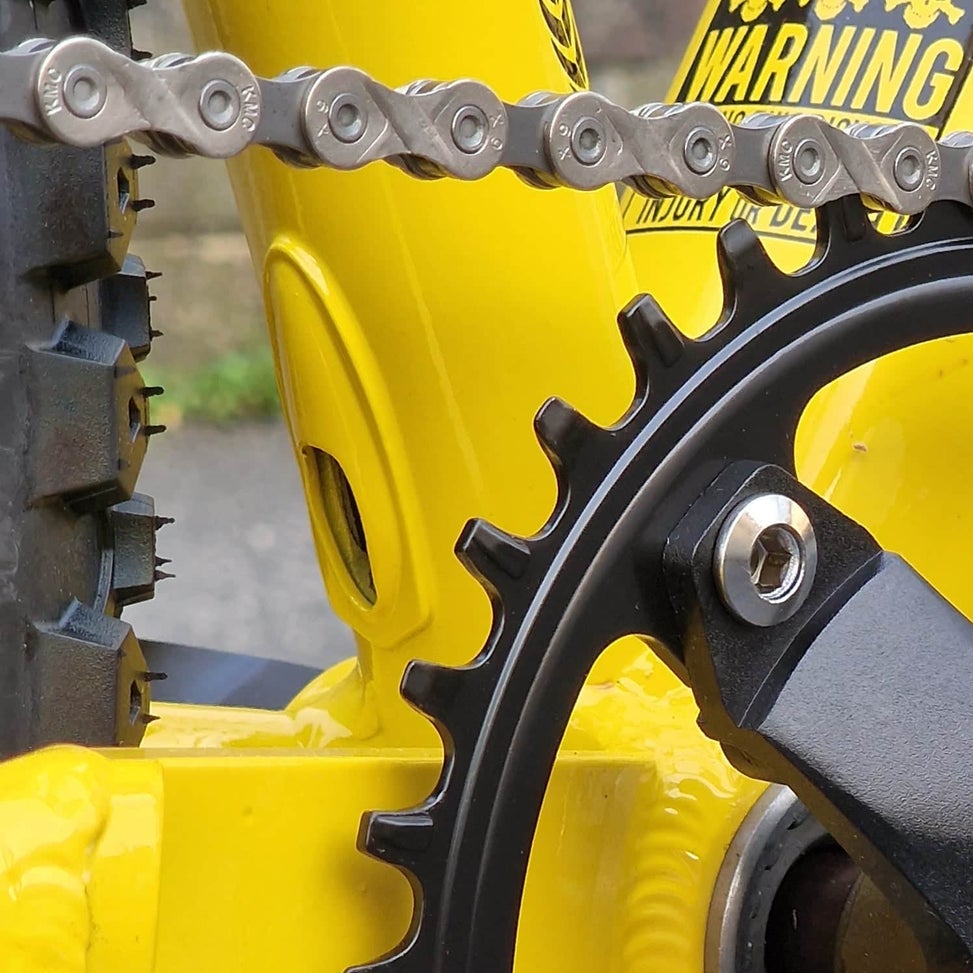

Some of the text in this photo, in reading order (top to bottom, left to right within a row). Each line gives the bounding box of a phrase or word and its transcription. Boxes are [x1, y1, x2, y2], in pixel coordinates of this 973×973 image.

[45, 67, 64, 117] KMC
[689, 23, 966, 121] WARNING
[241, 85, 261, 132] KMC
[778, 139, 794, 183] KMC
[926, 150, 940, 192] KMC
[636, 187, 731, 224] INJURY
